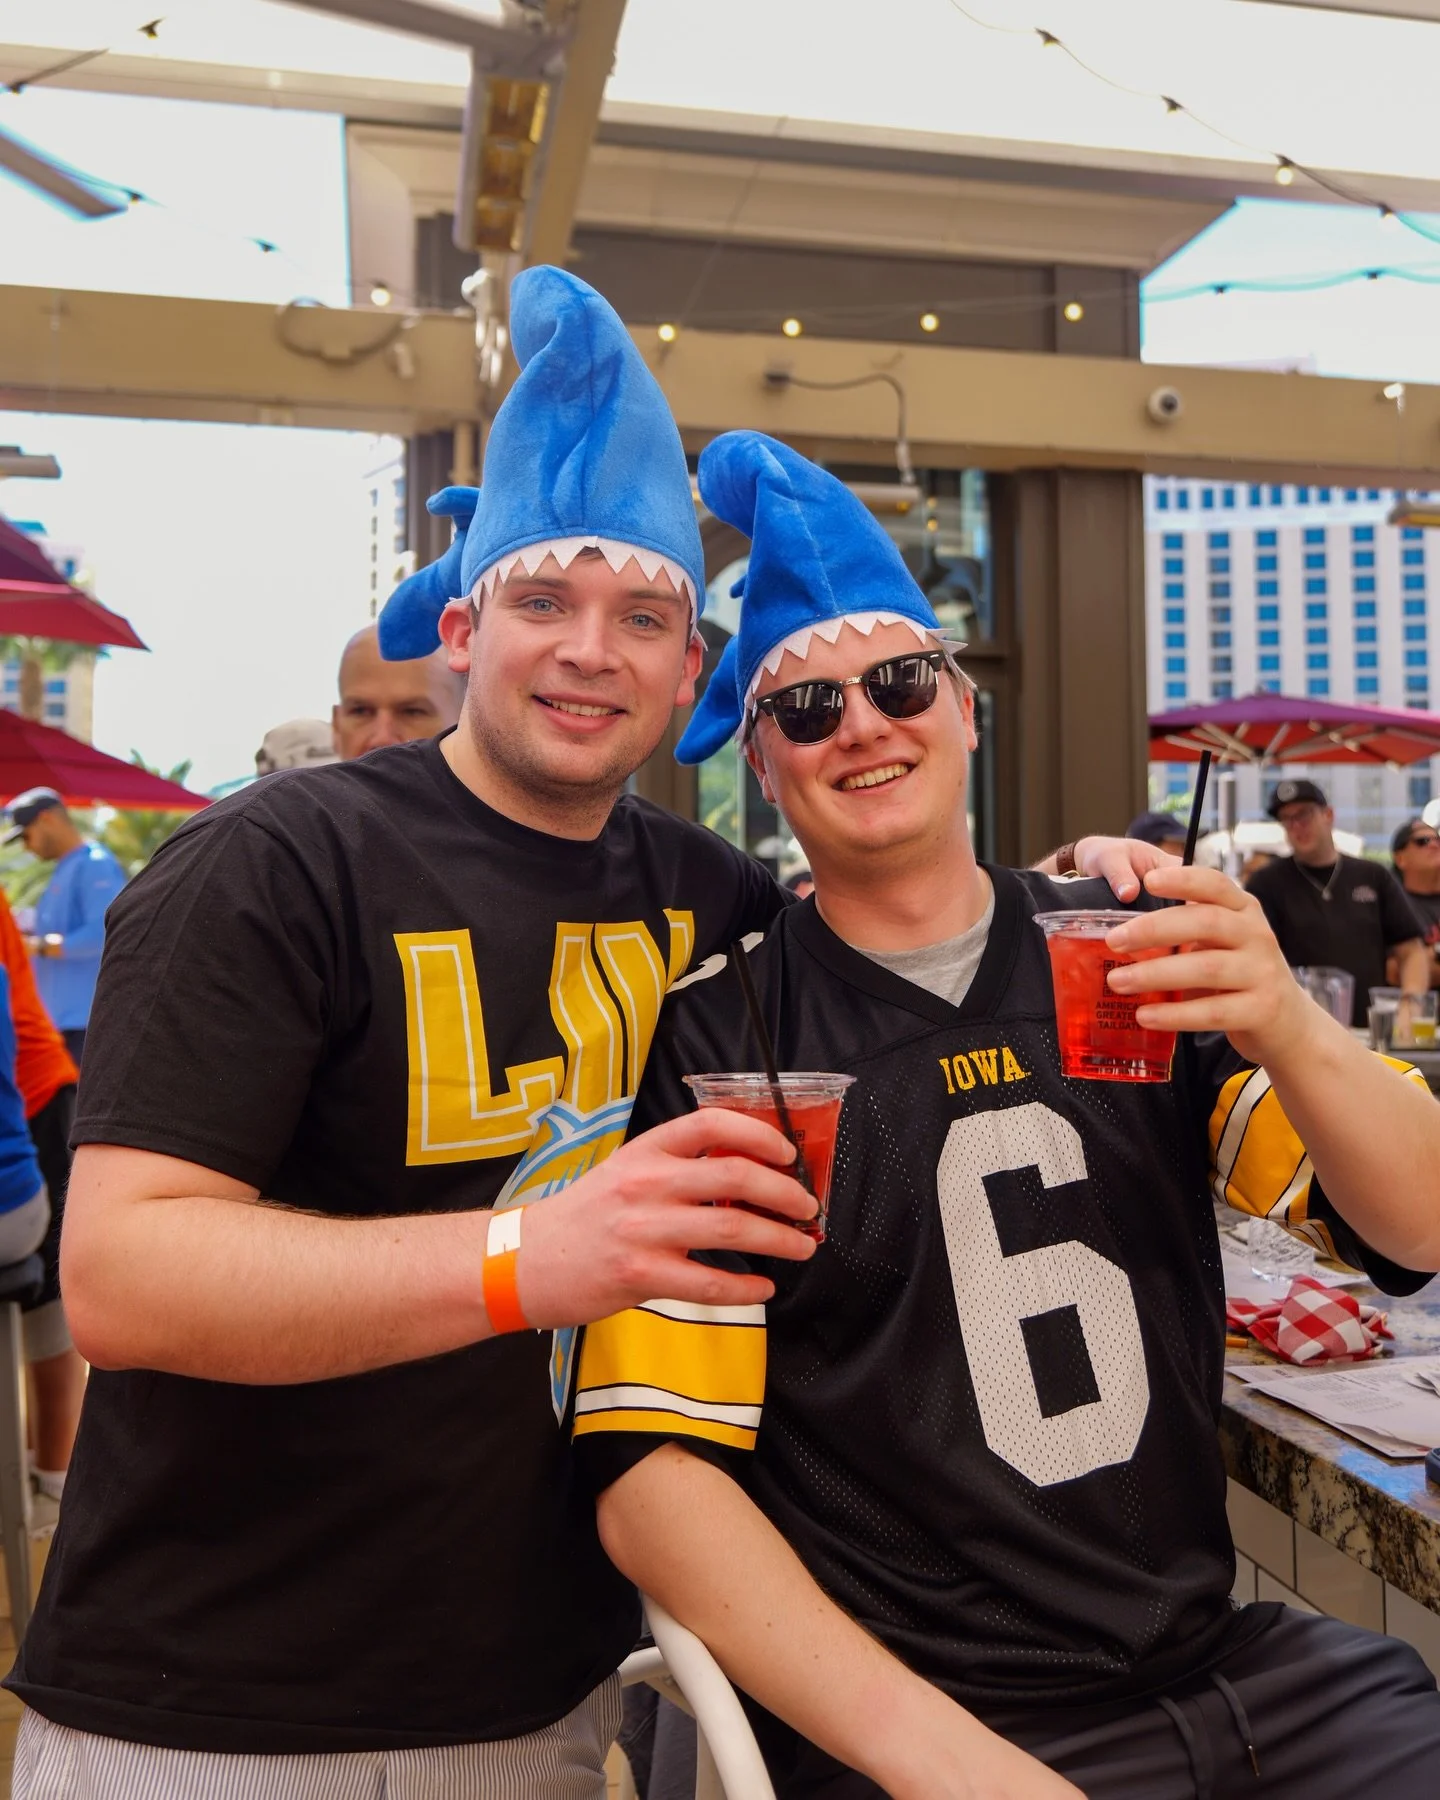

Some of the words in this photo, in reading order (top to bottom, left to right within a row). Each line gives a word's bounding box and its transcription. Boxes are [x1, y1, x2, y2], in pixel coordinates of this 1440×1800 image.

[1095, 1001, 1139, 1010] AMERICA
[1096, 1010, 1136, 1020] GREATE
[938, 1046, 1026, 1095] IOWA
[936, 1101, 1150, 1487] 6
